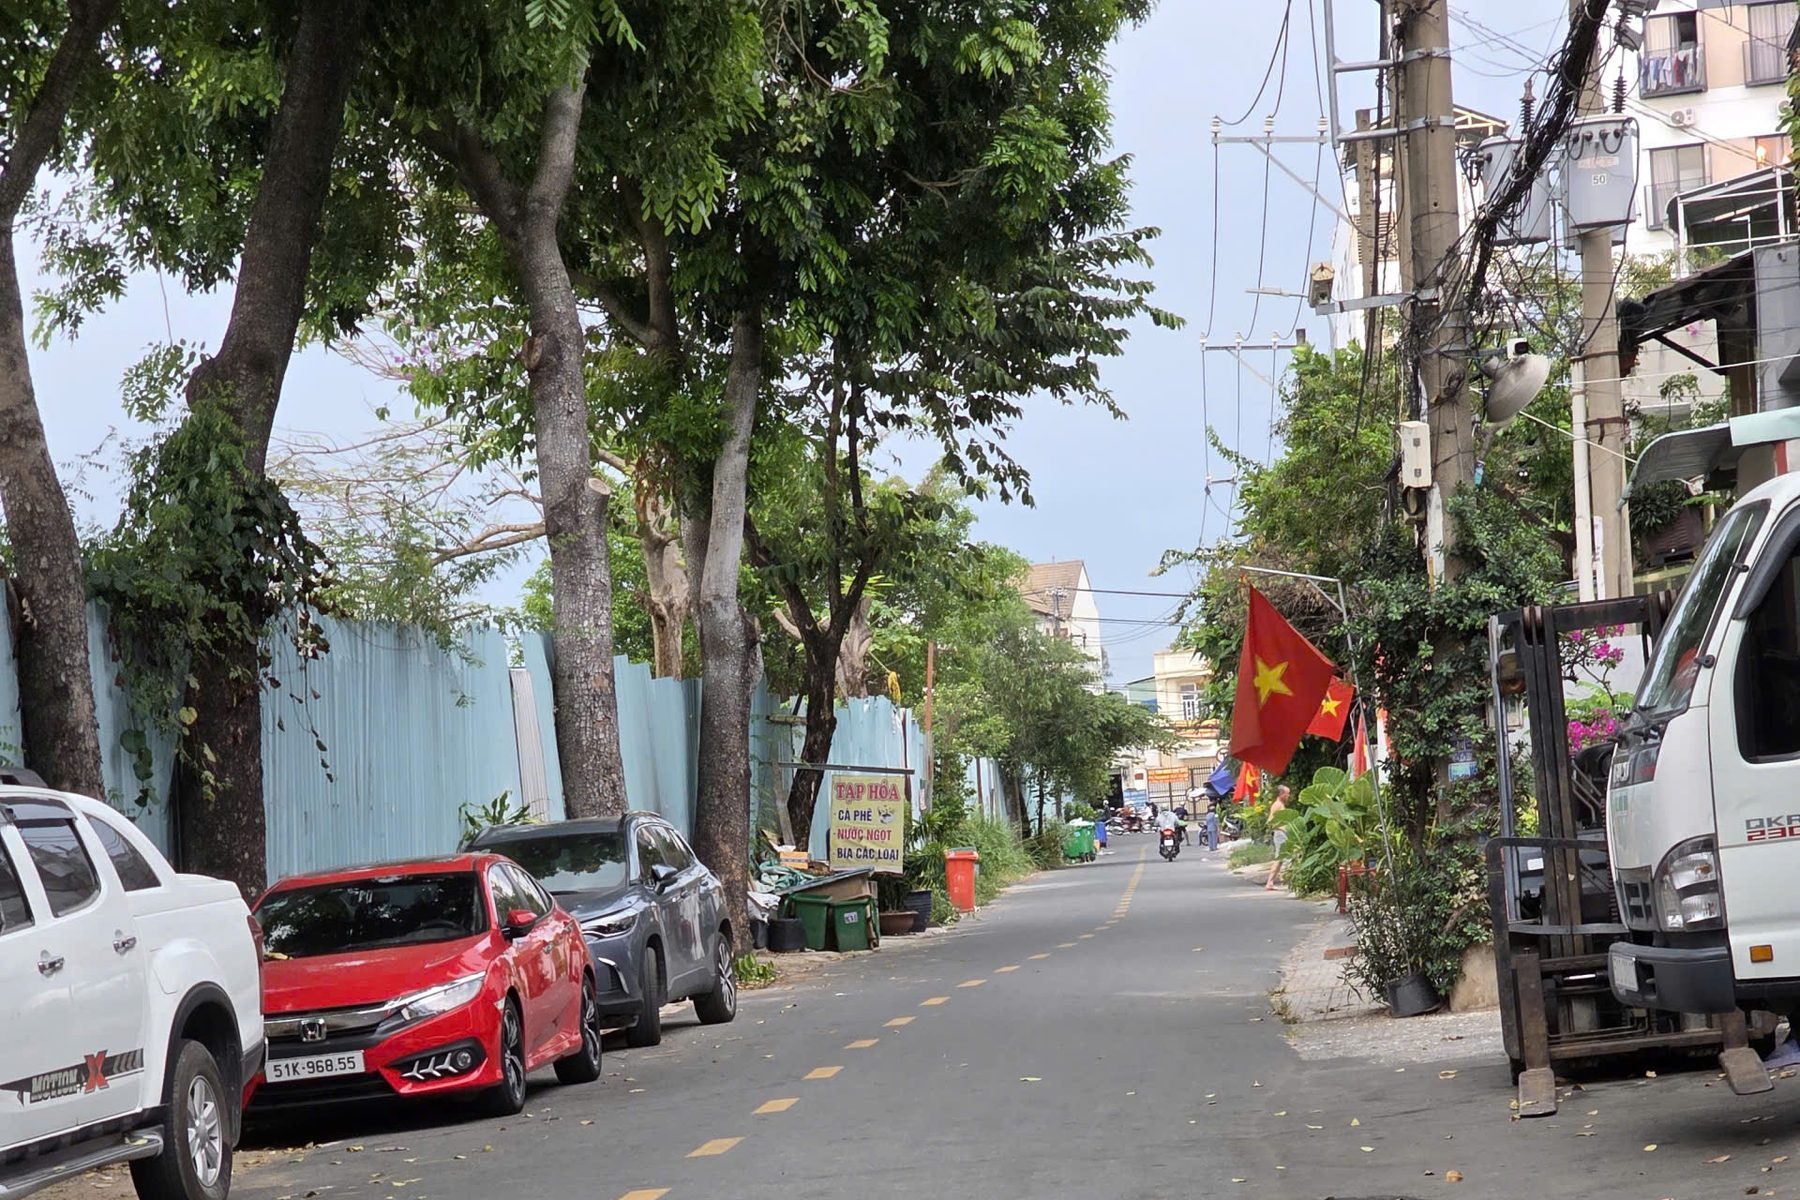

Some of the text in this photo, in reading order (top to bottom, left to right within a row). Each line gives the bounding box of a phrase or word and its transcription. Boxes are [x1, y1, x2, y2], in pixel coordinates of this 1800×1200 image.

[1593, 175, 1606, 185] 50
[836, 783, 865, 804] TẠP
[853, 808, 873, 821] PHÊ
[837, 826, 892, 843] NƯỚC NGỌT
[837, 846, 899, 862] BIA CÁC LOẠI
[273, 1056, 356, 1078] 51K-968.55
